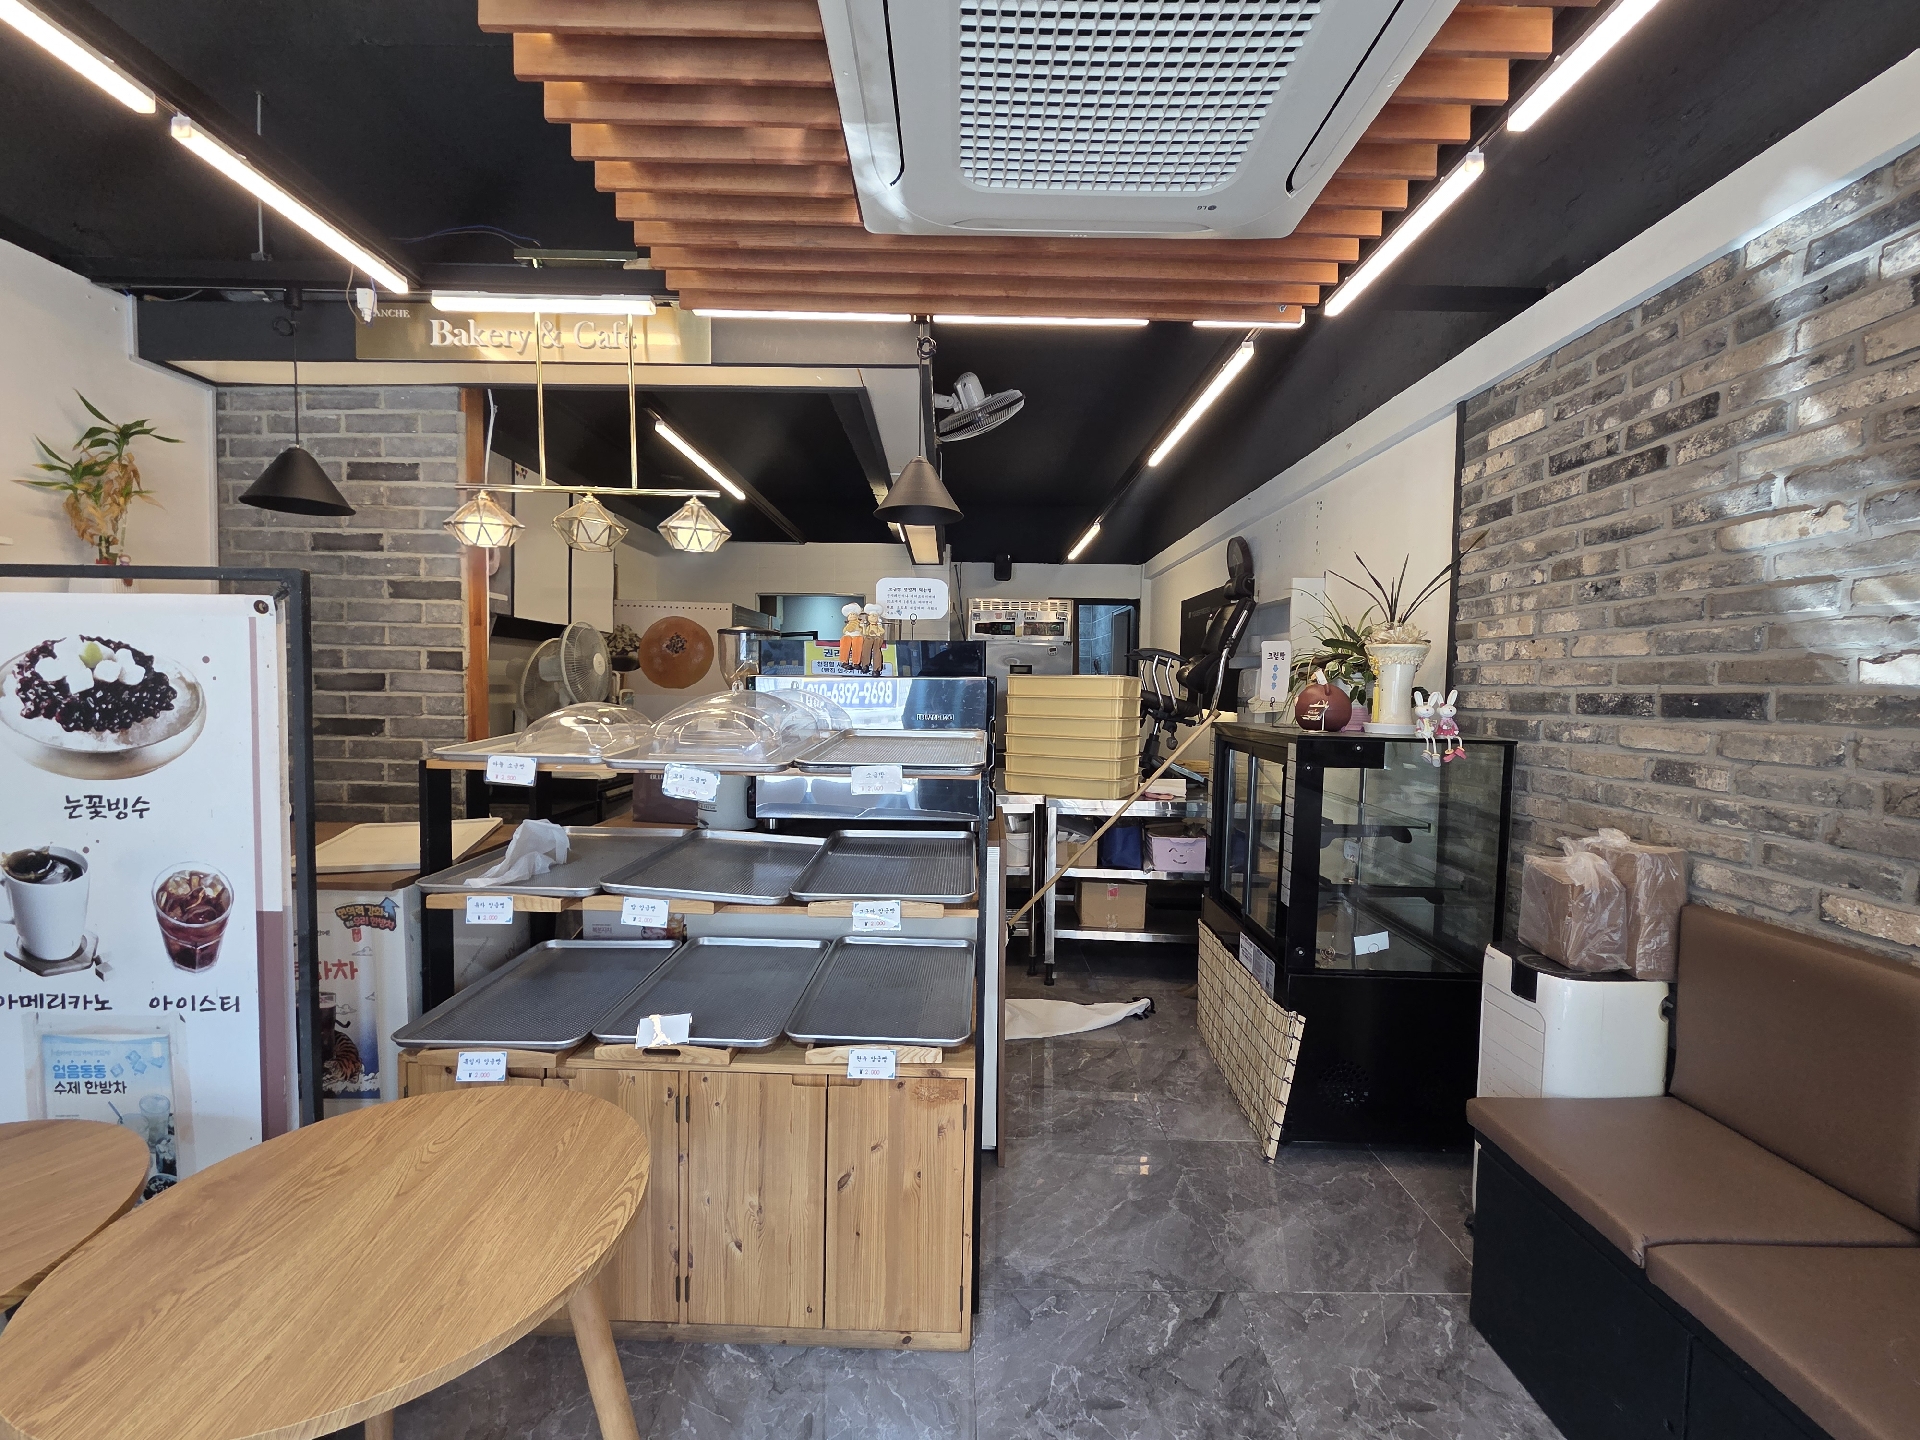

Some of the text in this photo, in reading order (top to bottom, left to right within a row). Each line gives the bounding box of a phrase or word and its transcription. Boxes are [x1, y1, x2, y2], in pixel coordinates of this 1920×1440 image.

[429, 318, 532, 356] Bakery
[541, 320, 565, 350] &
[1267, 651, 1286, 661] 크림빵
[63, 794, 151, 820] 눈꽃빙수
[0, 992, 113, 1012] 아메리카노
[148, 994, 241, 1013] 아이스티
[52, 1064, 107, 1080] 얼음동동
[53, 1080, 128, 1095] 수제 한방차
